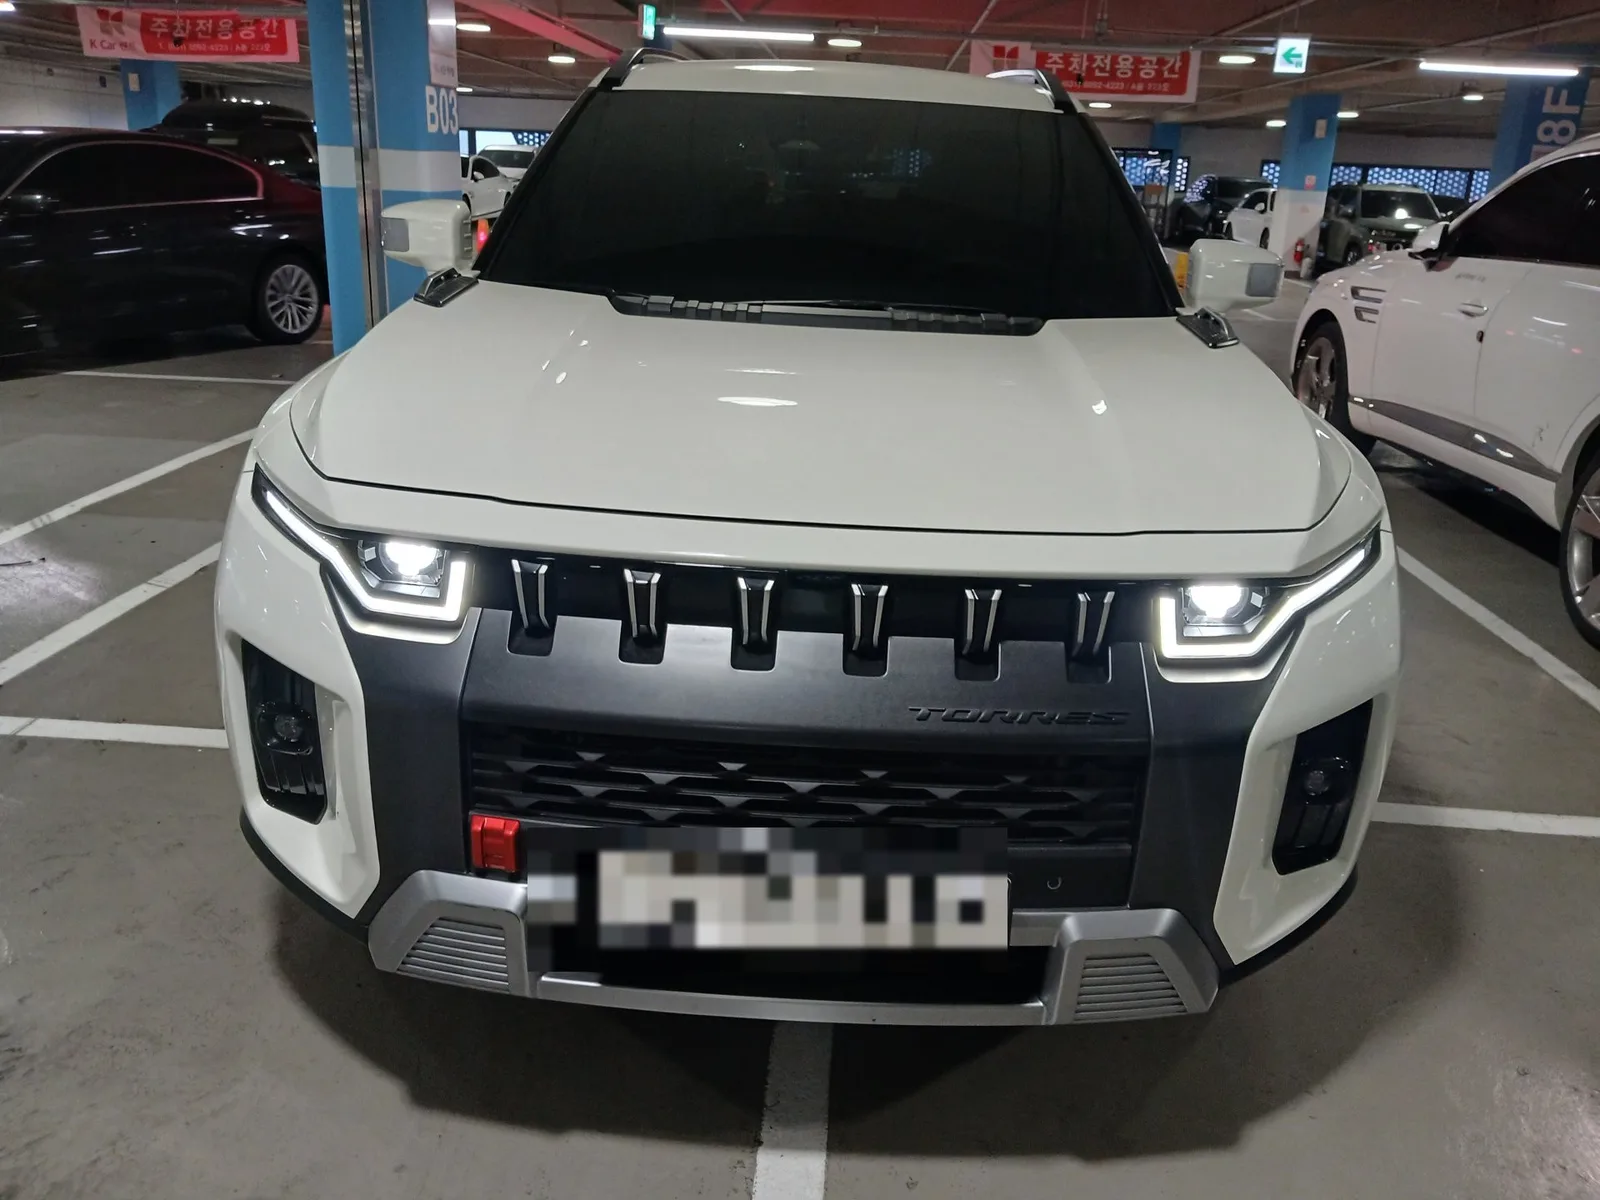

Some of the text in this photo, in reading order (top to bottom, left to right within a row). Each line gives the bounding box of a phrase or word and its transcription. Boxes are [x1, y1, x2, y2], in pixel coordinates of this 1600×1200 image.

[89, 39, 97, 49] K
[100, 39, 116, 50] Car
[1044, 52, 1182, 79] 주차전용공간
[426, 84, 459, 135] B03
[908, 706, 1131, 726] TORRES
